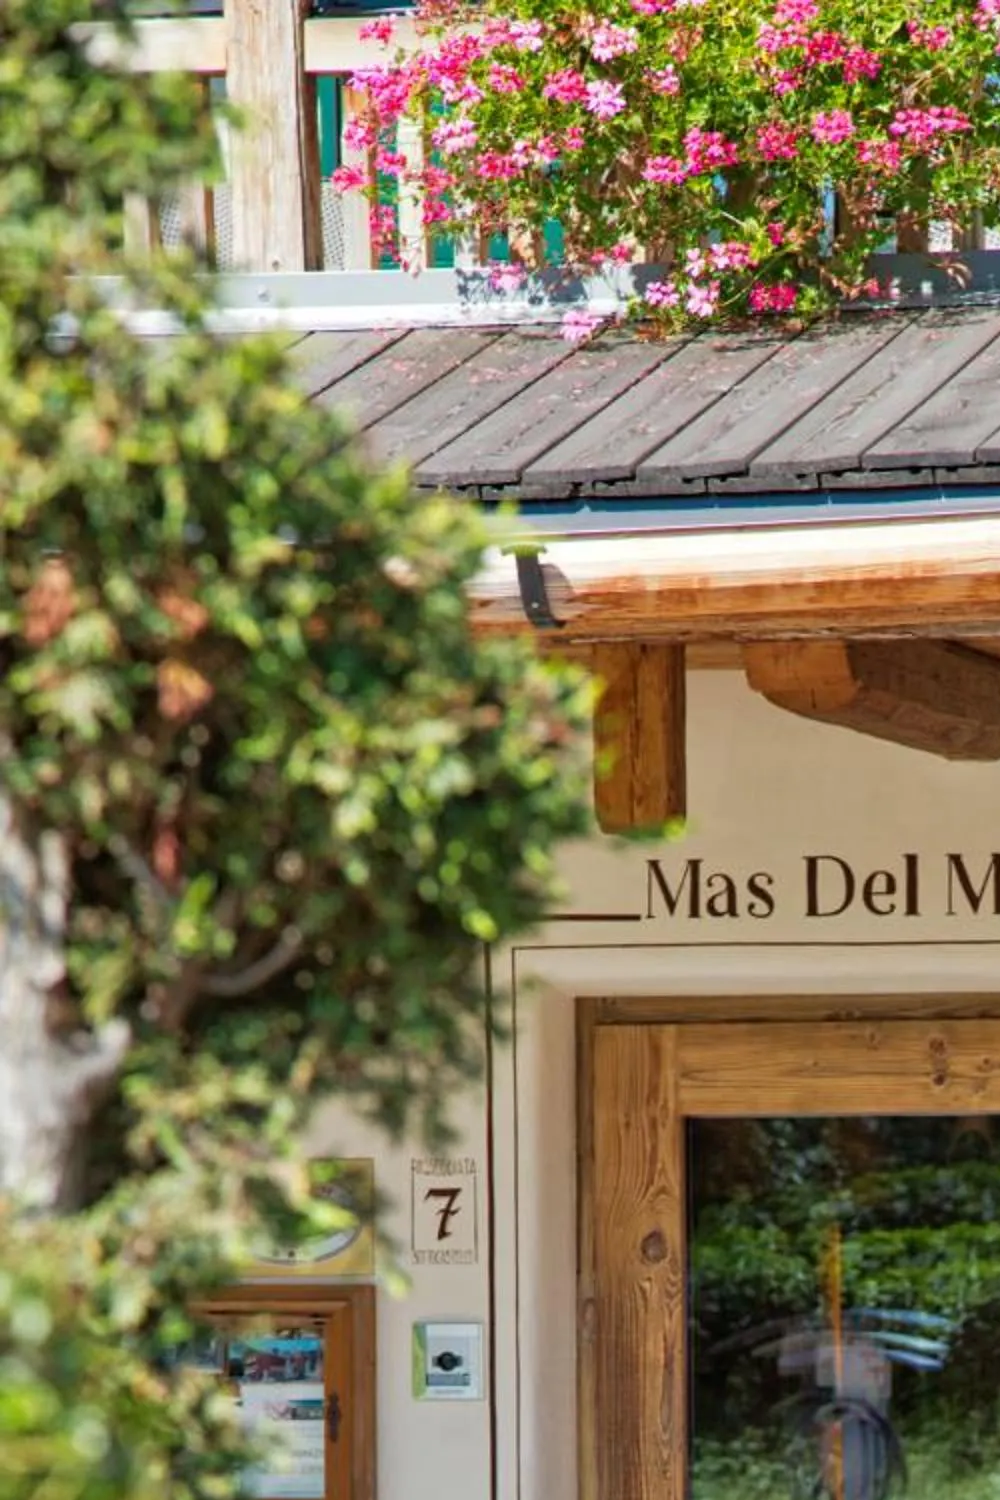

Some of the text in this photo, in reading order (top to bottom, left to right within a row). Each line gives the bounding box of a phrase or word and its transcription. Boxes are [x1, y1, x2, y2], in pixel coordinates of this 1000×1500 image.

[645, 857, 776, 920] Mas
[802, 852, 921, 918] Del
[423, 1186, 463, 1241] 7
